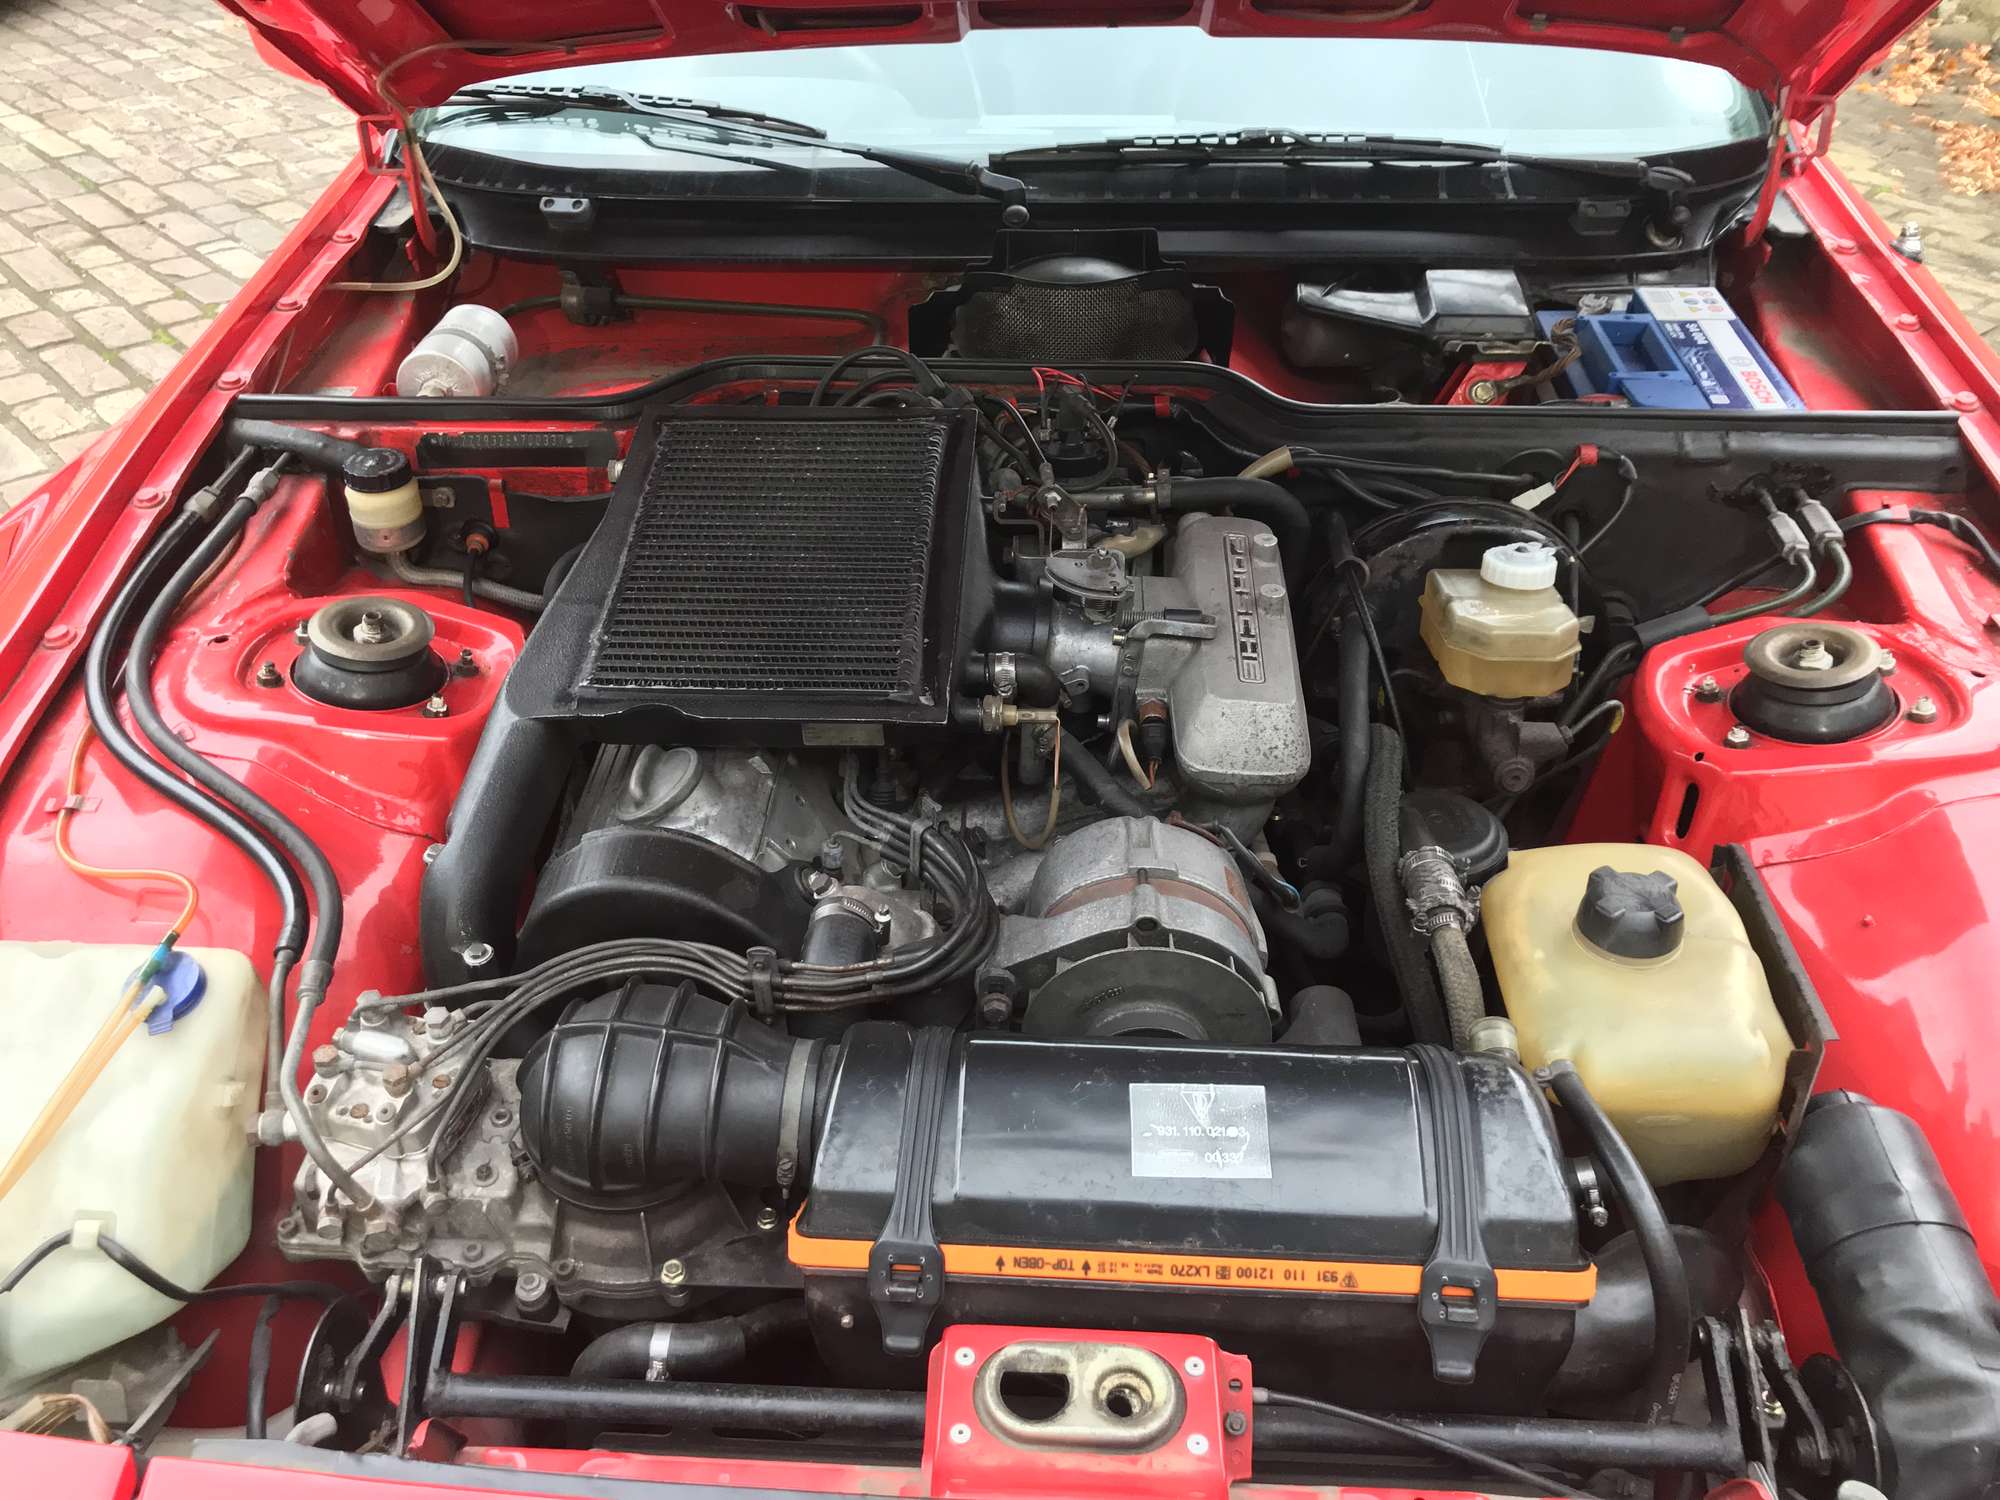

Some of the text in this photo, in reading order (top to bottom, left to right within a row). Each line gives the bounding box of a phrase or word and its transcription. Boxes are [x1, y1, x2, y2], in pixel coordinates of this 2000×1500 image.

[1740, 369, 1777, 404] BOSCH
[1013, 1256, 1075, 1272] TOP-OBEN
[1170, 1263, 1339, 1284] 931 110 12100 LX270
